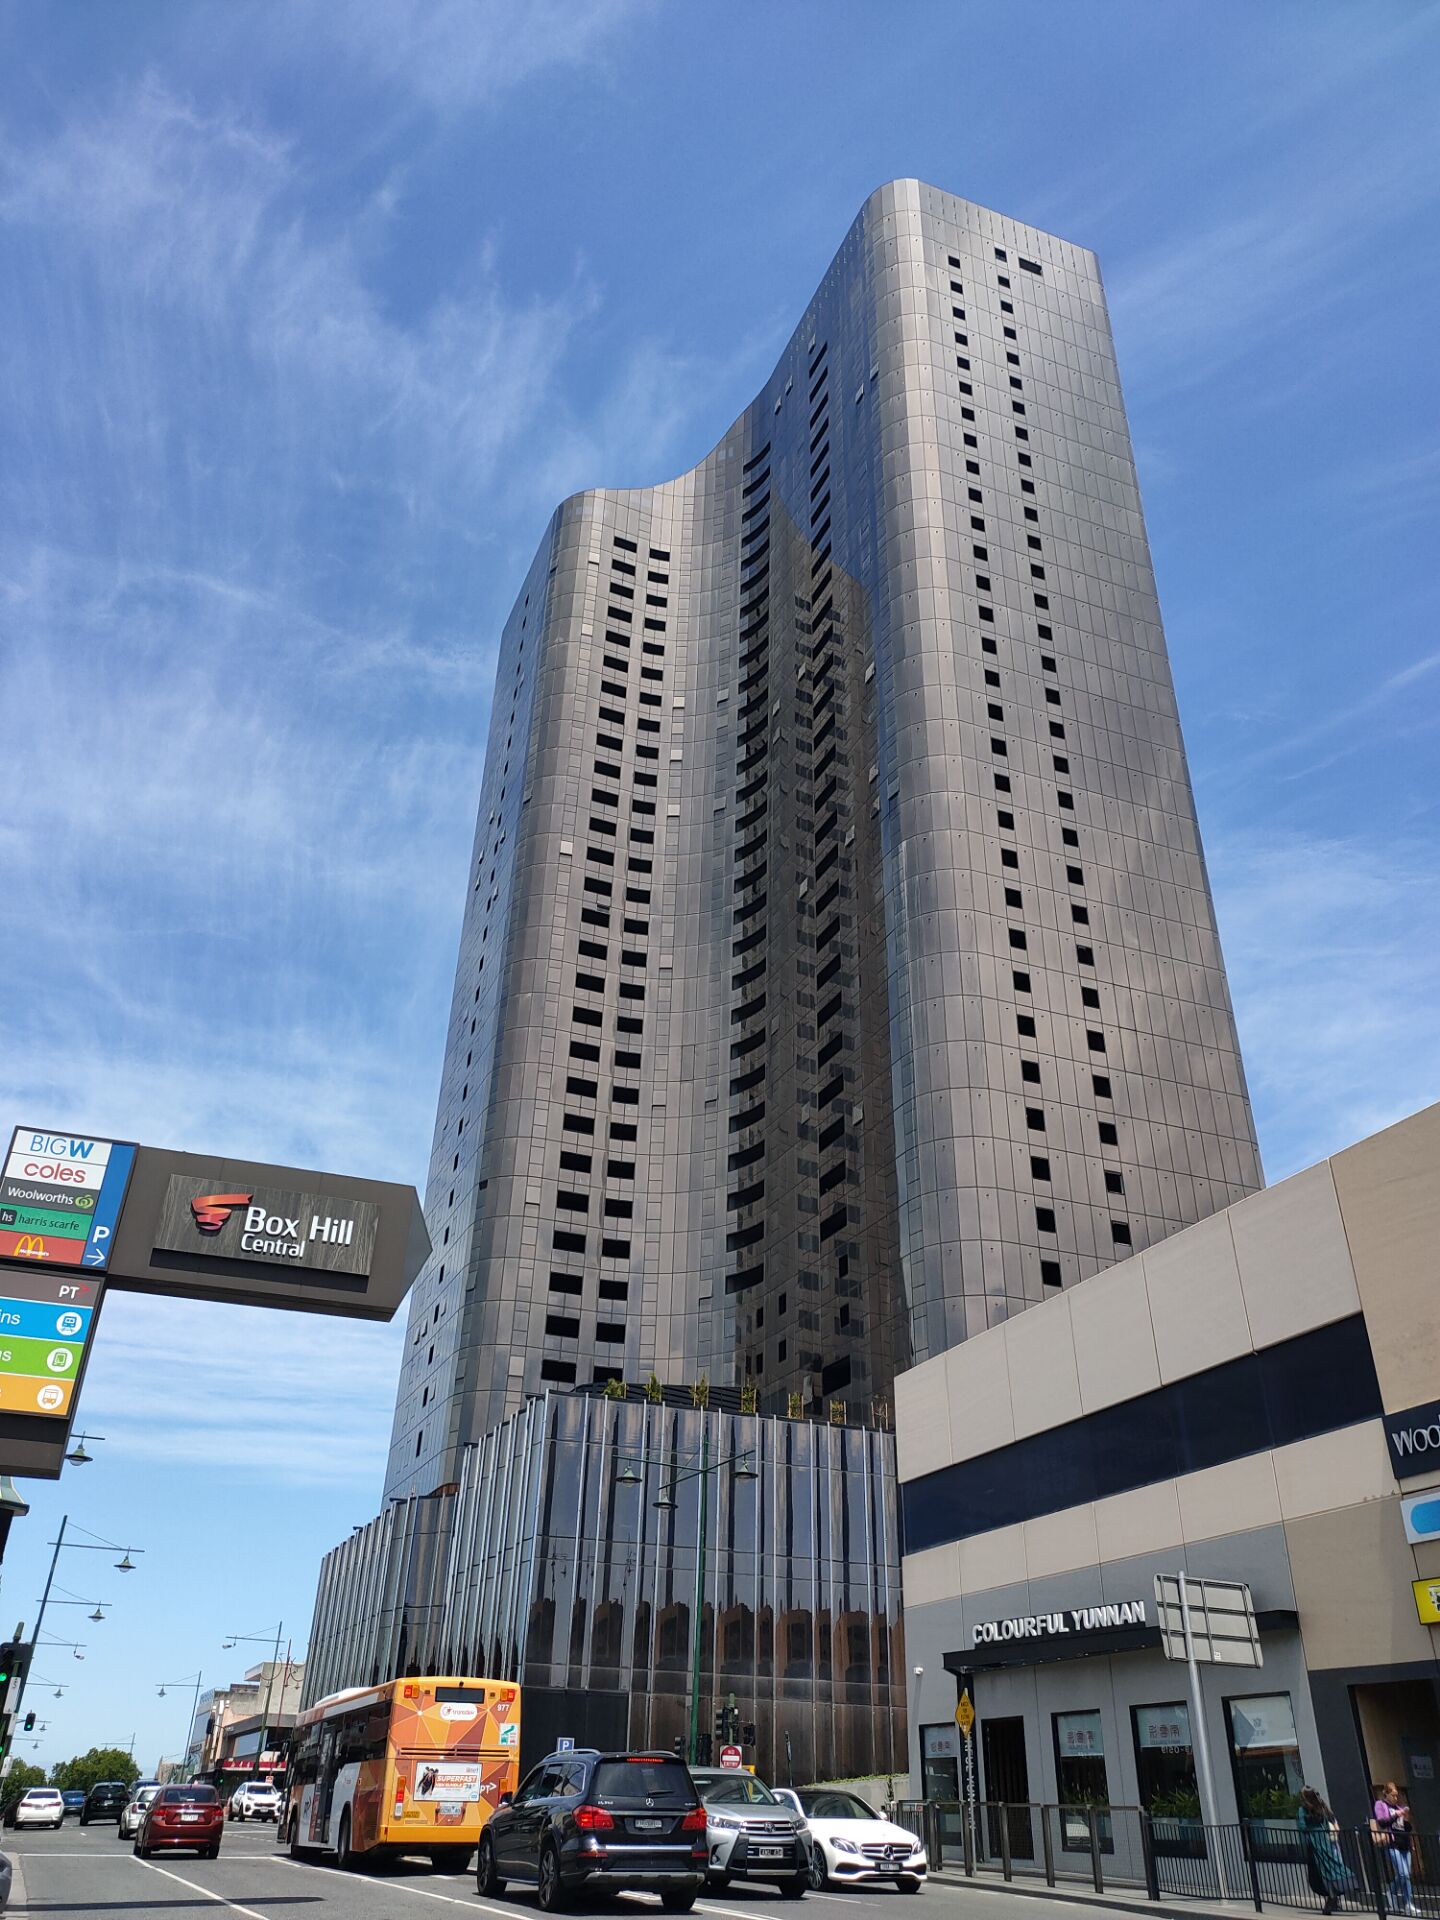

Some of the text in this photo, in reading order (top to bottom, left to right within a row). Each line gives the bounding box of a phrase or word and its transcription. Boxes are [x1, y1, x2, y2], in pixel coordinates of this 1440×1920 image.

[24, 1163, 86, 1183] coles
[8, 1186, 74, 1205] Woolworths
[2, 1212, 80, 1231] hs harris scarfe
[244, 1206, 354, 1246] Box Hill
[92, 1226, 110, 1243] P
[241, 1233, 306, 1258] Central
[972, 1600, 1146, 1644] COLOURFUL YUNNAN
[497, 1704, 510, 1712] 977
[562, 1740, 570, 1751] P
